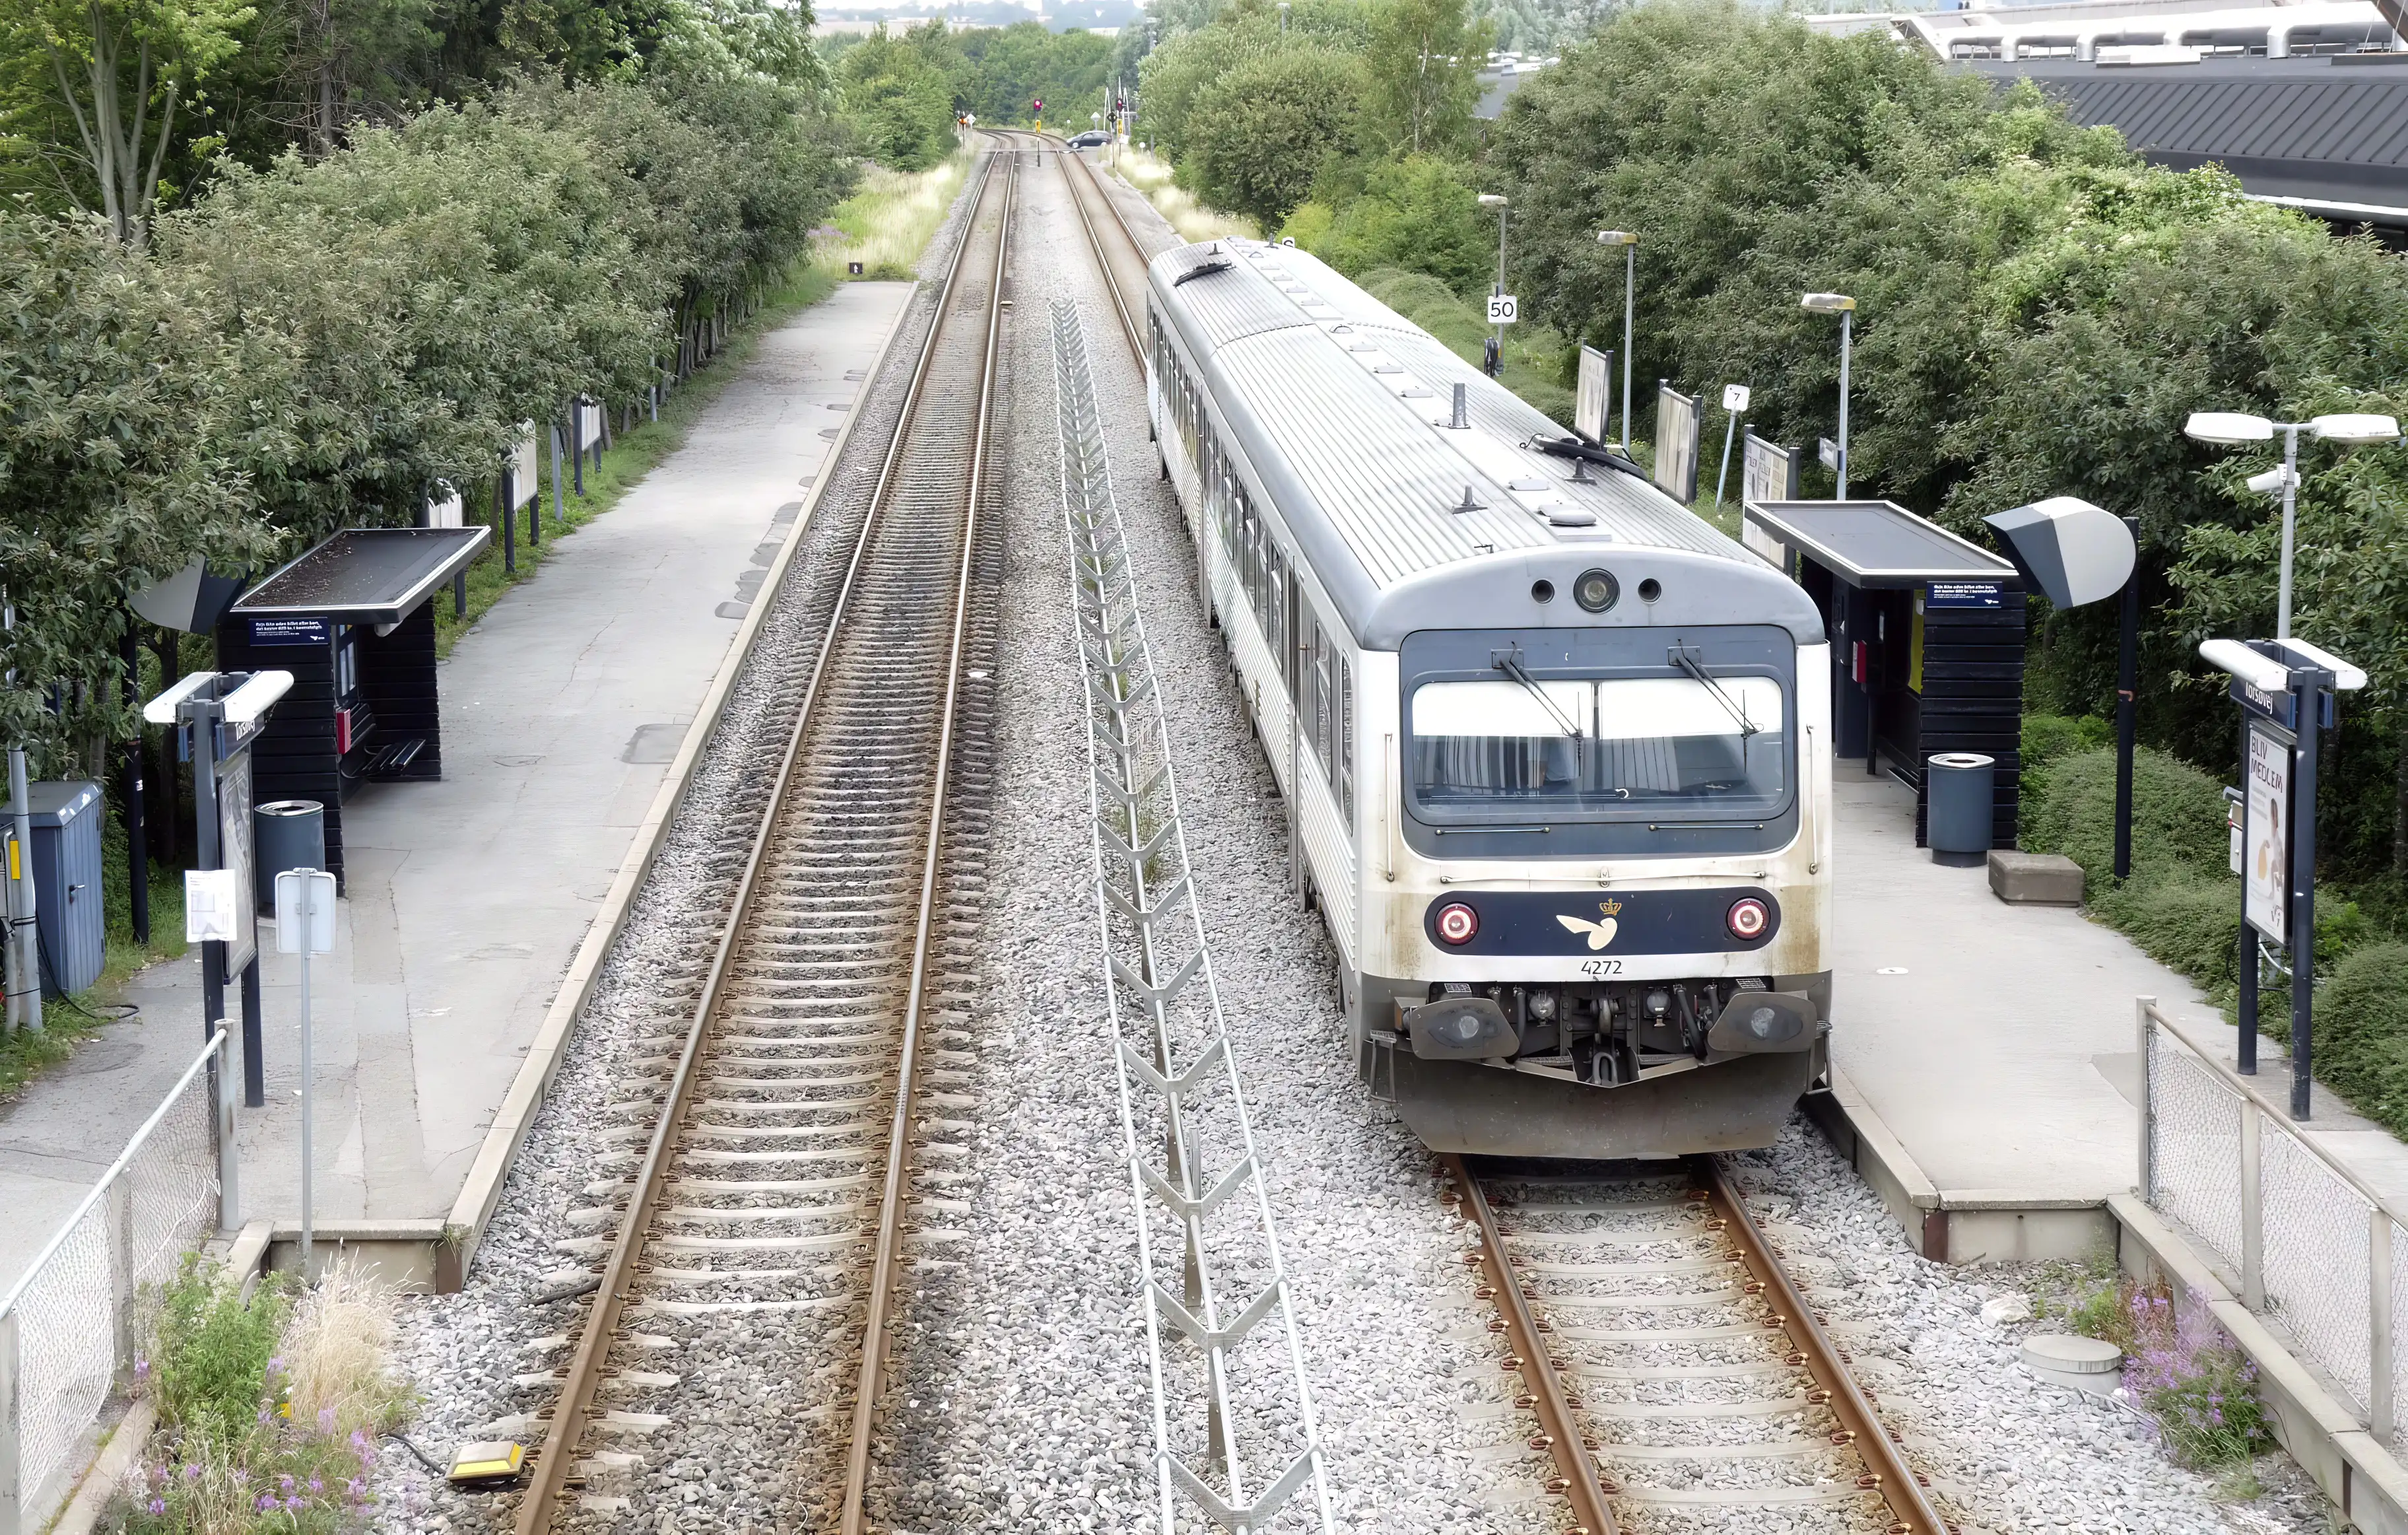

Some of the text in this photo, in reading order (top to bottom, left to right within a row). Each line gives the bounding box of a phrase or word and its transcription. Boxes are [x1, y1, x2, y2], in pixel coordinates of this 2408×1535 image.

[1491, 302, 1514, 317] 50
[2252, 735, 2267, 759] BLIV
[1581, 960, 1622, 974] 4272
